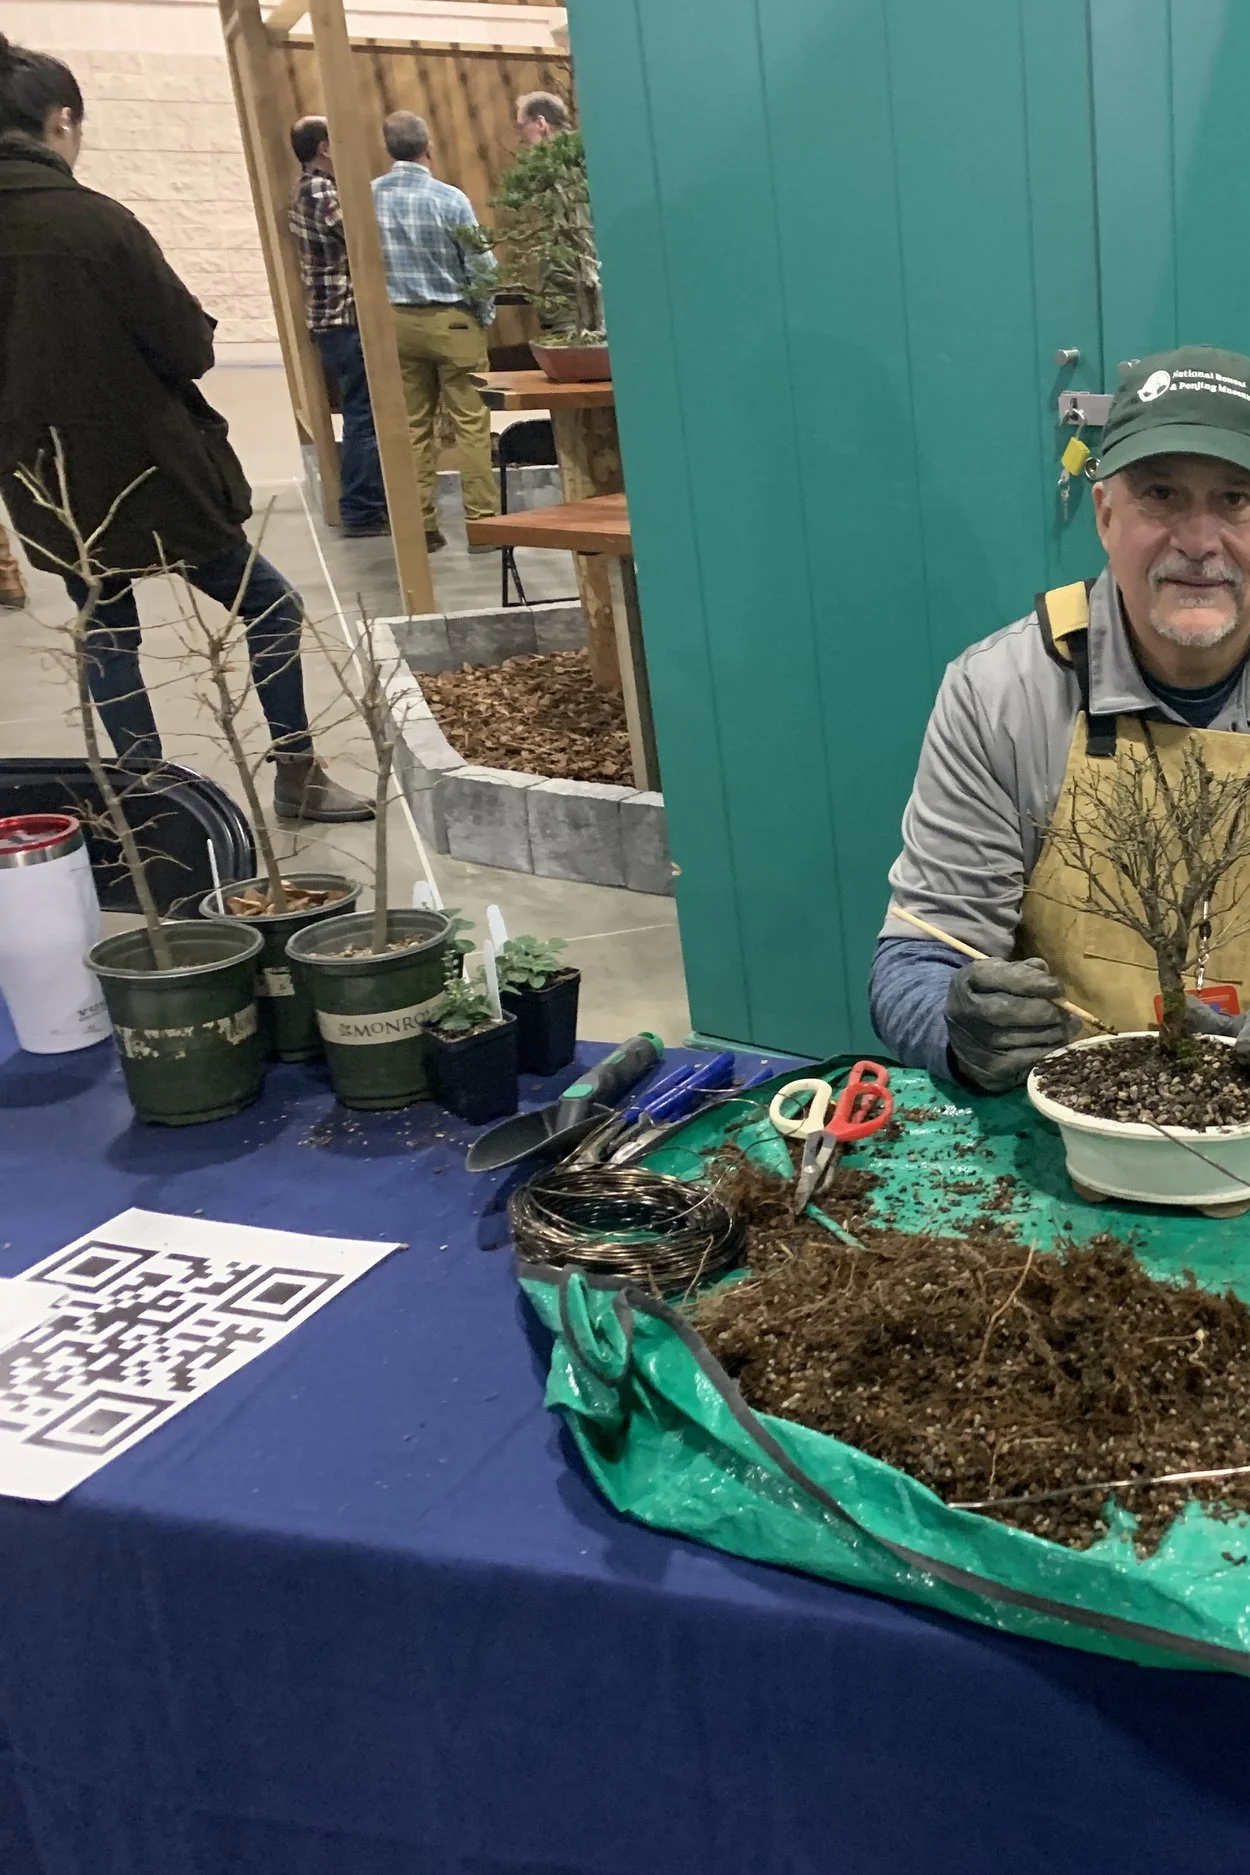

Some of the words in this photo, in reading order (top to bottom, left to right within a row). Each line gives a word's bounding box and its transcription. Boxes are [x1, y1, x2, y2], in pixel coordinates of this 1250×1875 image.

[1172, 369, 1214, 380] National
[1169, 383, 1178, 391] &
[1179, 381, 1218, 393] Penjing
